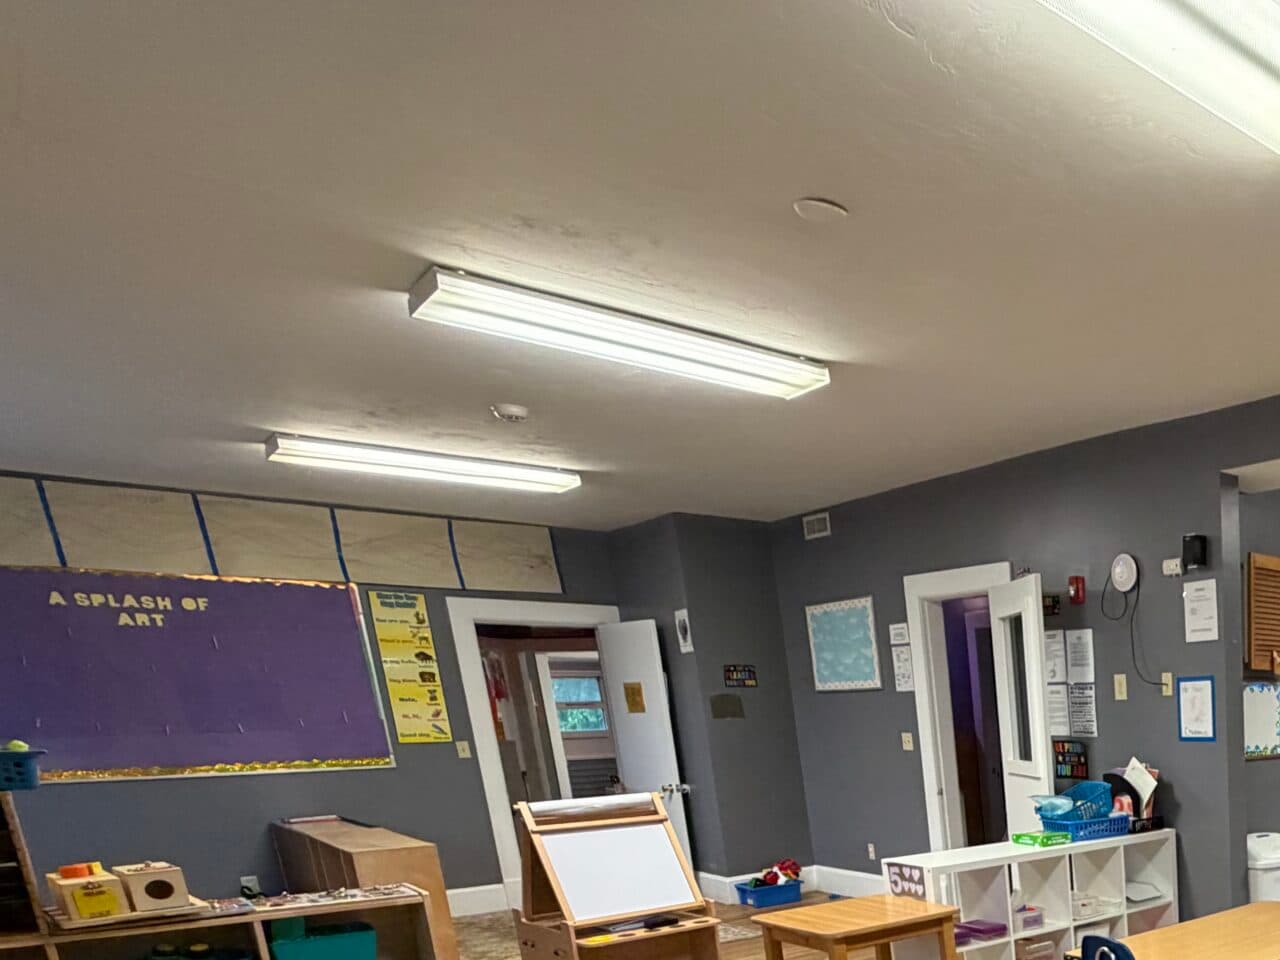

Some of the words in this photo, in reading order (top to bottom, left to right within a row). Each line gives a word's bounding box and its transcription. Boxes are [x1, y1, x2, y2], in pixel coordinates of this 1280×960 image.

[48, 591, 68, 606] A
[74, 592, 173, 611] SPLASH
[181, 597, 209, 611] OF
[118, 612, 166, 627] ART
[889, 866, 902, 894] 5
